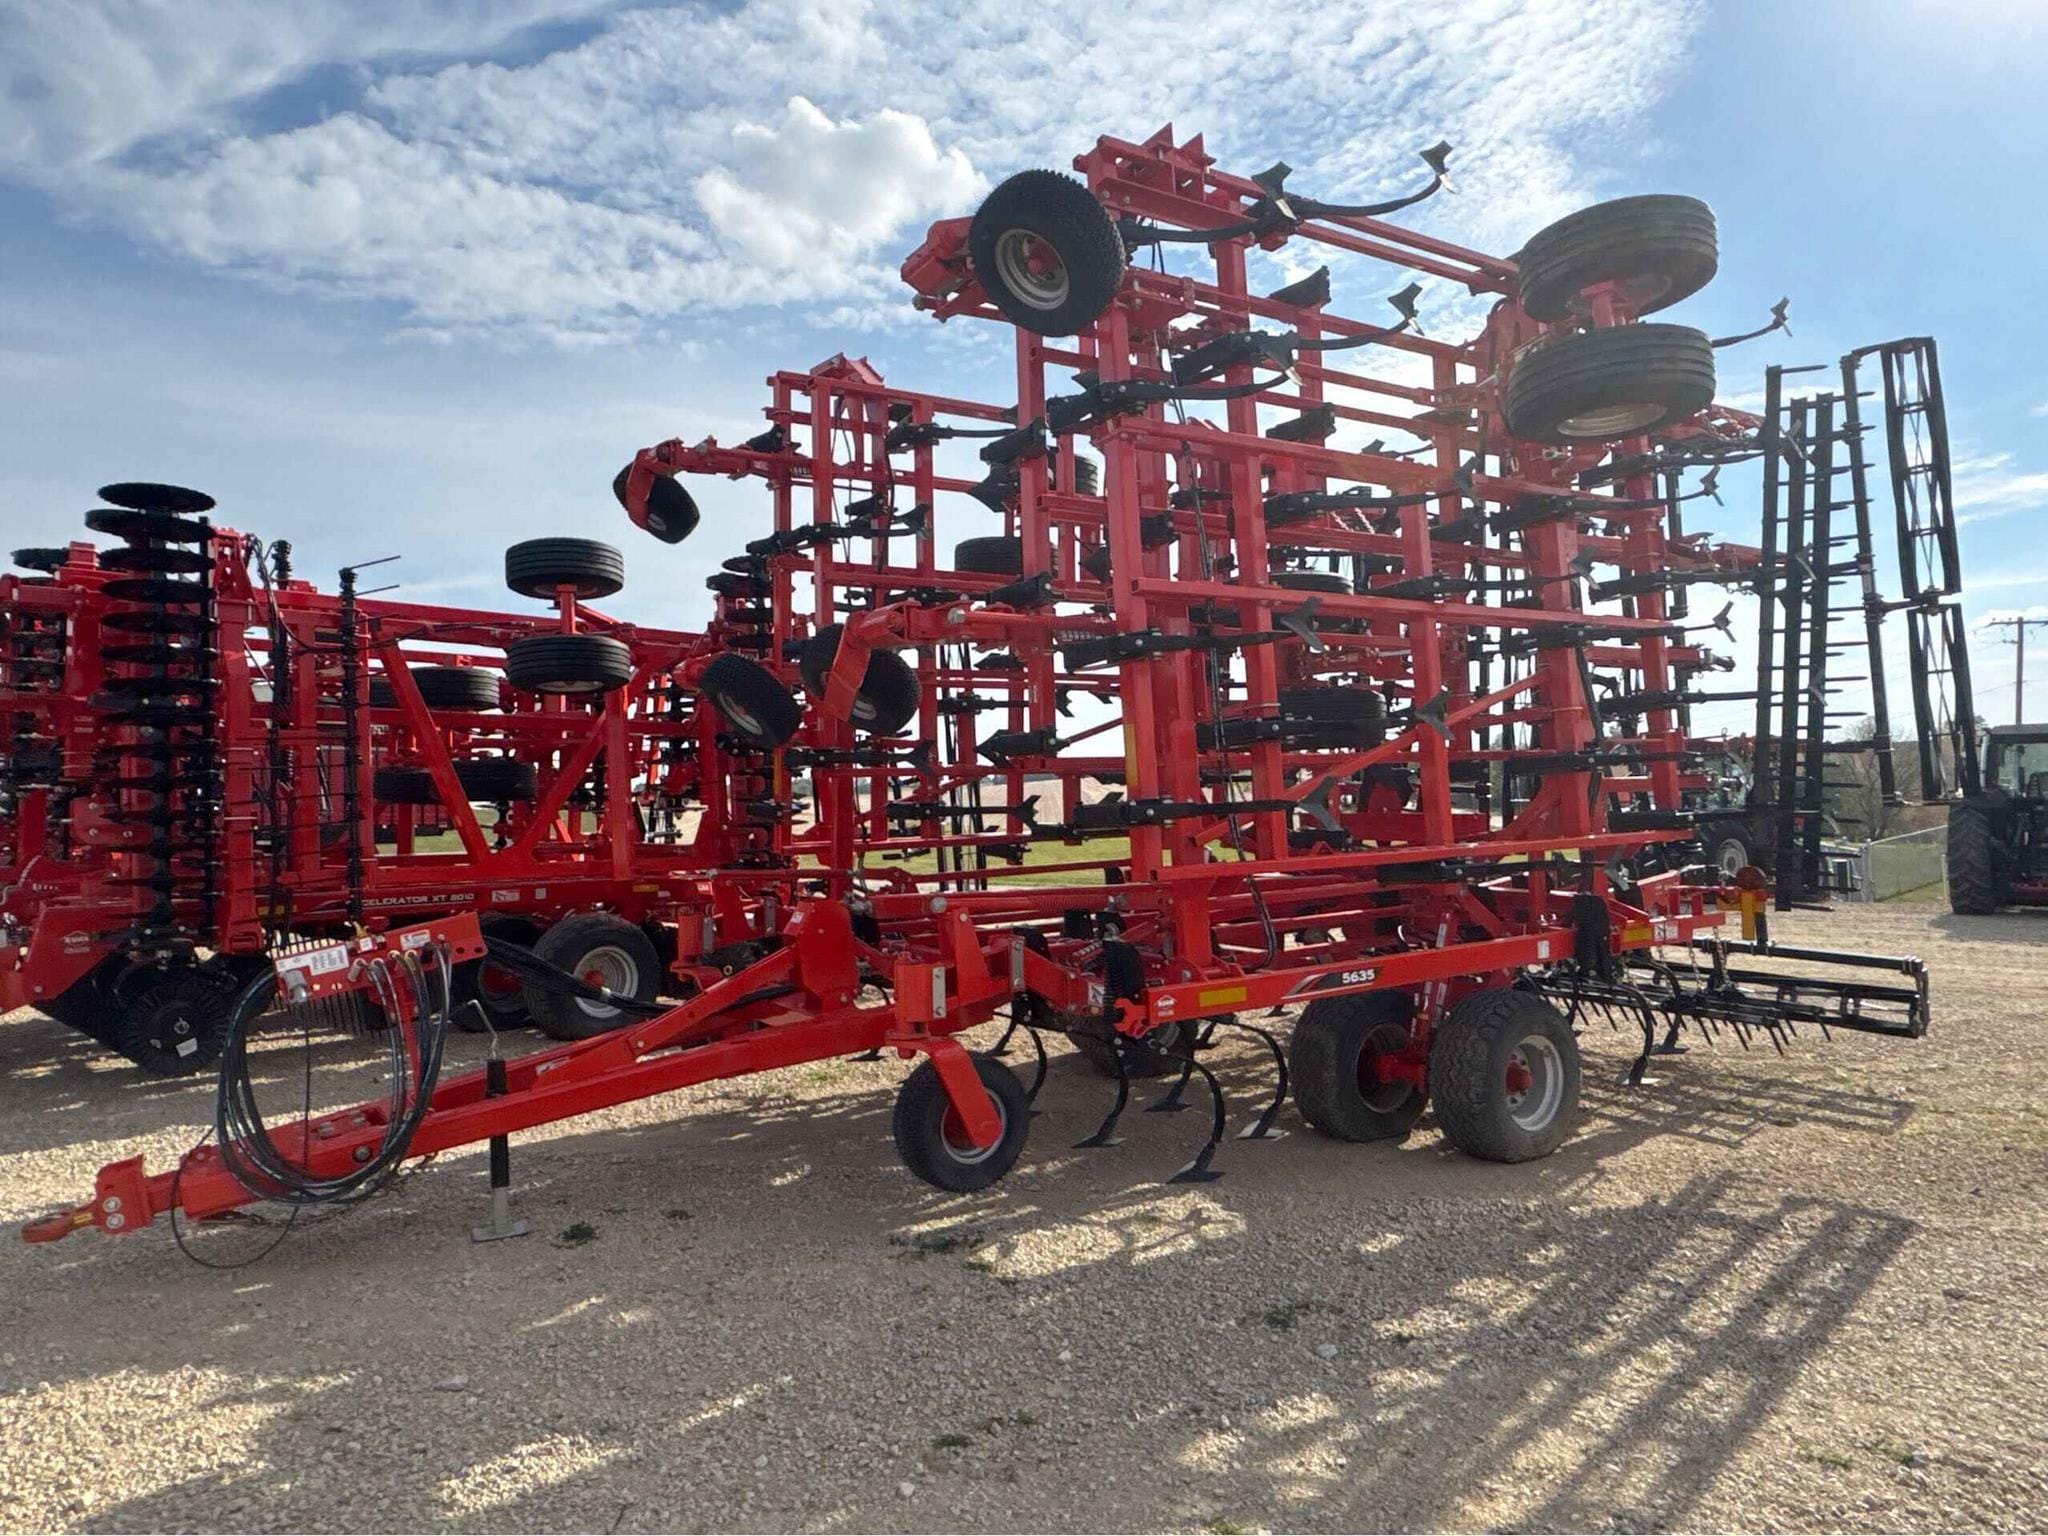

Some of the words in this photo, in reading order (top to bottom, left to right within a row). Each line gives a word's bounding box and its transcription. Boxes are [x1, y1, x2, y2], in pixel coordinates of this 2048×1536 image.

[361, 895, 428, 906] CELERATOR
[432, 894, 446, 902] XT
[1342, 969, 1376, 984] 5635
